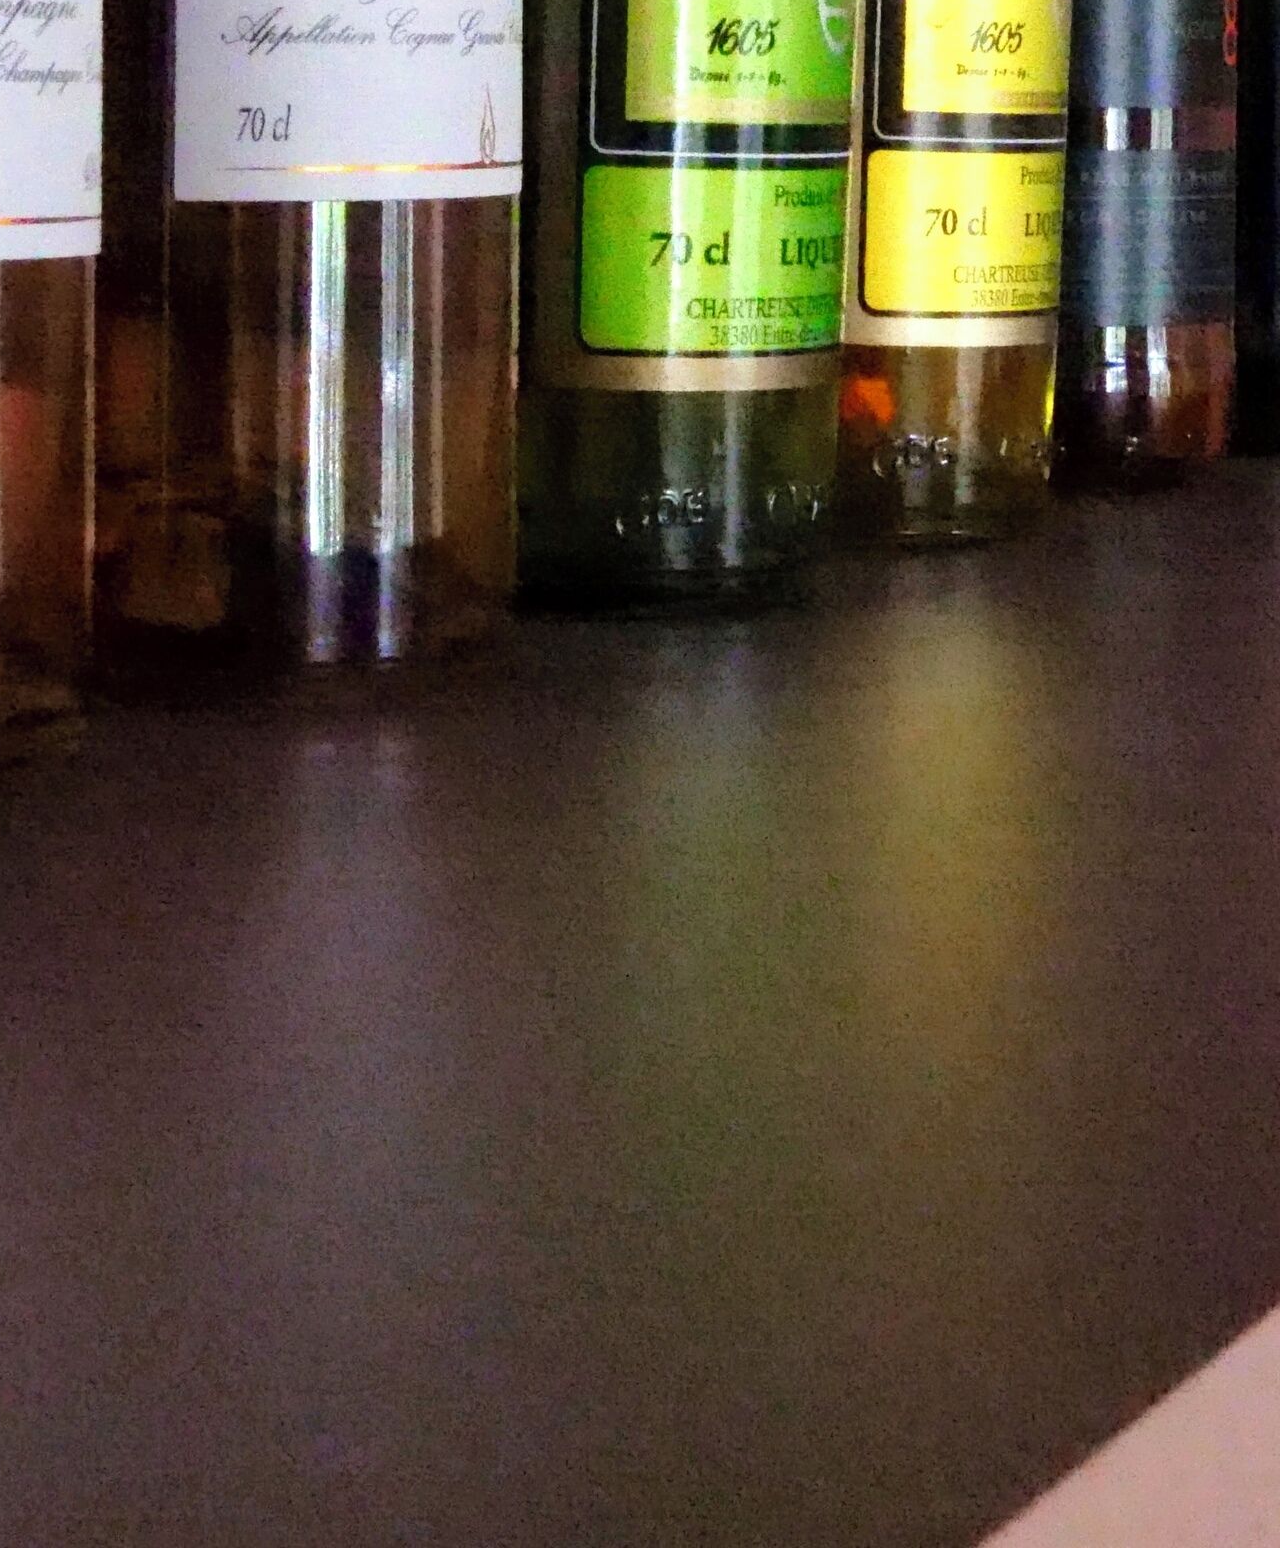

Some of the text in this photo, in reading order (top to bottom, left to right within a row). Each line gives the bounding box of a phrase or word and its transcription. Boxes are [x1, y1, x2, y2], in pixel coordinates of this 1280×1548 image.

[221, 6, 376, 56] Appellation
[706, 17, 781, 56] 1605
[970, 21, 1026, 54] 1605
[236, 103, 292, 142] 70 cl
[924, 208, 958, 236] 70
[967, 206, 988, 236] cl
[648, 231, 694, 268] 70
[703, 229, 731, 266] cl
